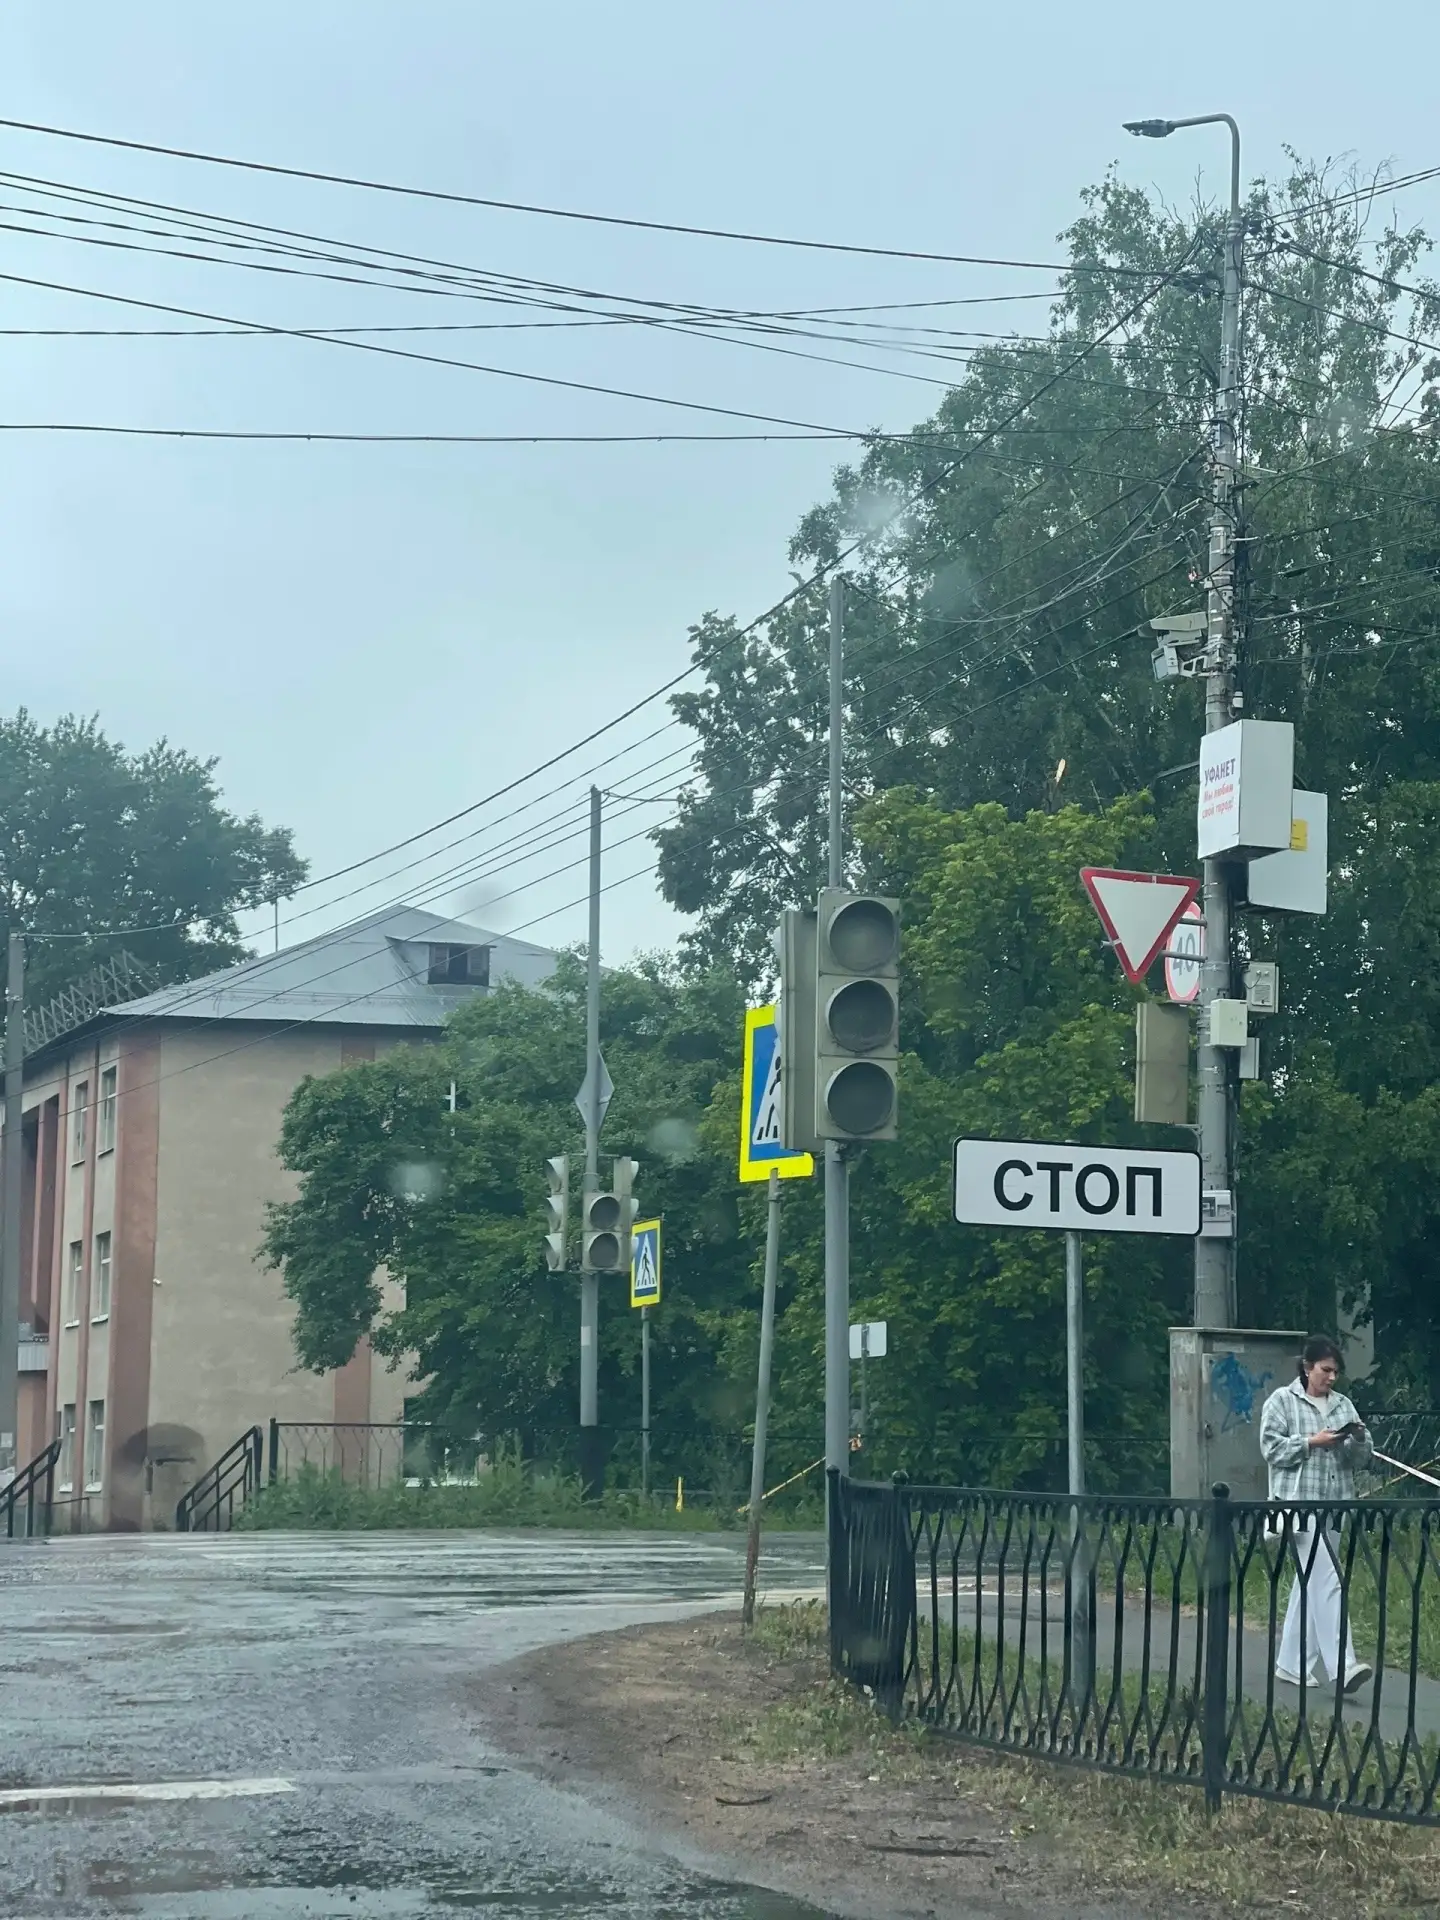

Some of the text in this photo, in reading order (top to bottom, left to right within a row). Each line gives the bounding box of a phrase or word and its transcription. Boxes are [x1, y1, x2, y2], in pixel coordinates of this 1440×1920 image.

[1204, 758, 1235, 787] УФАНЕТ
[1214, 783, 1233, 798] любим
[1202, 804, 1214, 818] свой
[1173, 933, 1195, 976] 40
[994, 1160, 1162, 1217] СТОП
